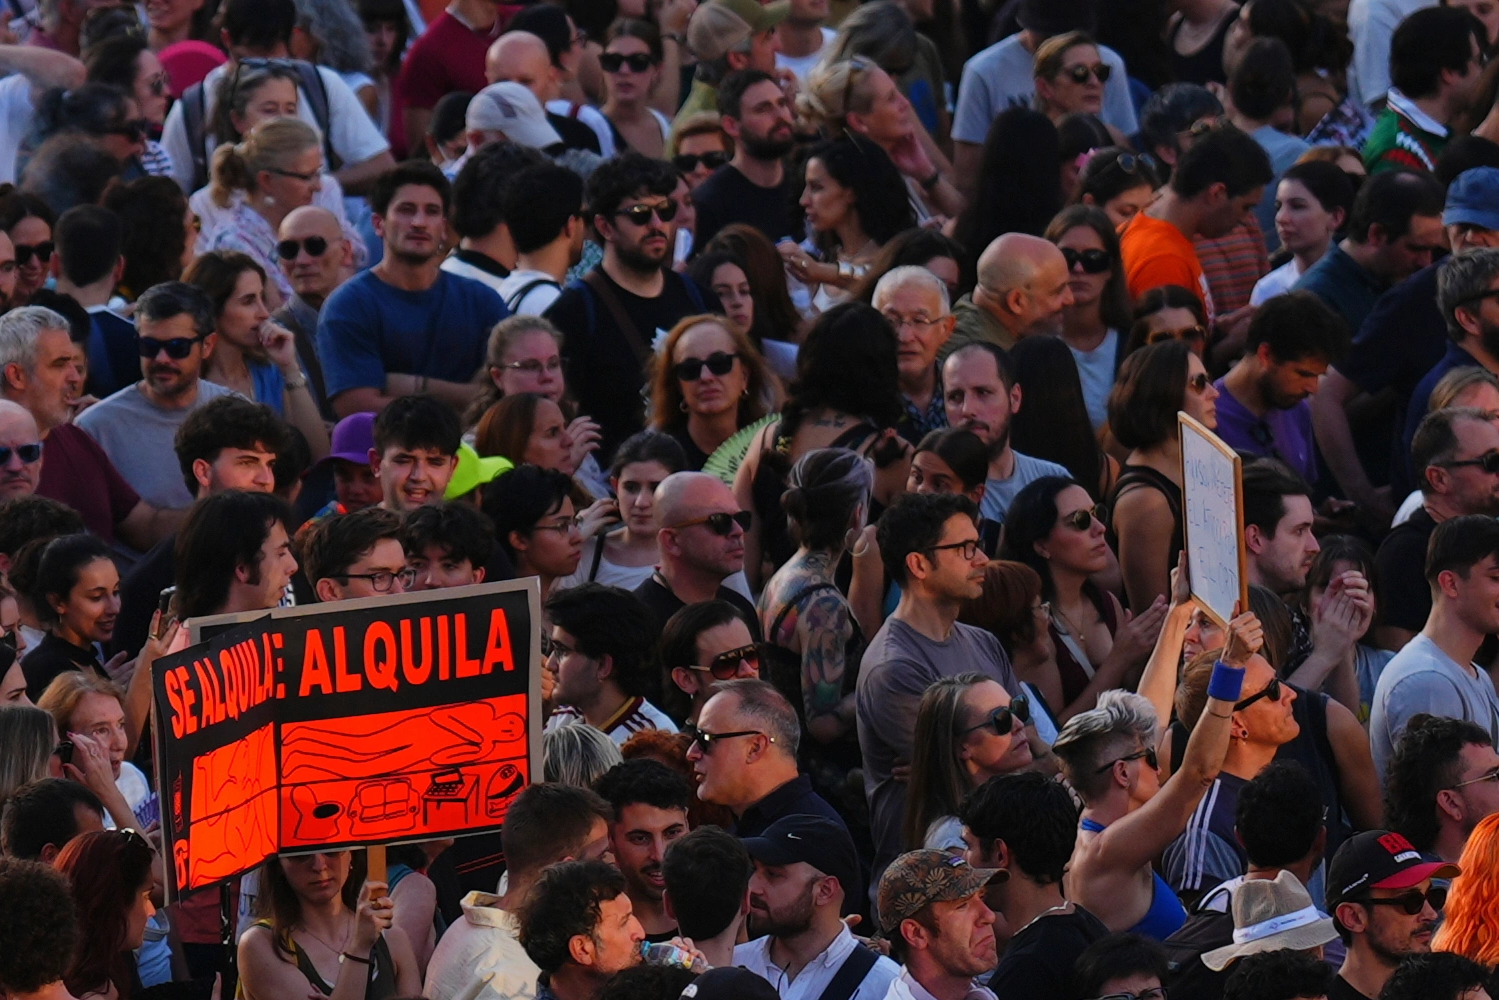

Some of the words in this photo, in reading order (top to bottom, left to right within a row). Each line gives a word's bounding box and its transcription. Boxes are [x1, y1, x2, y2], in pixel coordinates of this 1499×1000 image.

[165, 665, 198, 739] SE
[193, 632, 274, 728] ALQUILA
[298, 607, 514, 697] ALQUILA
